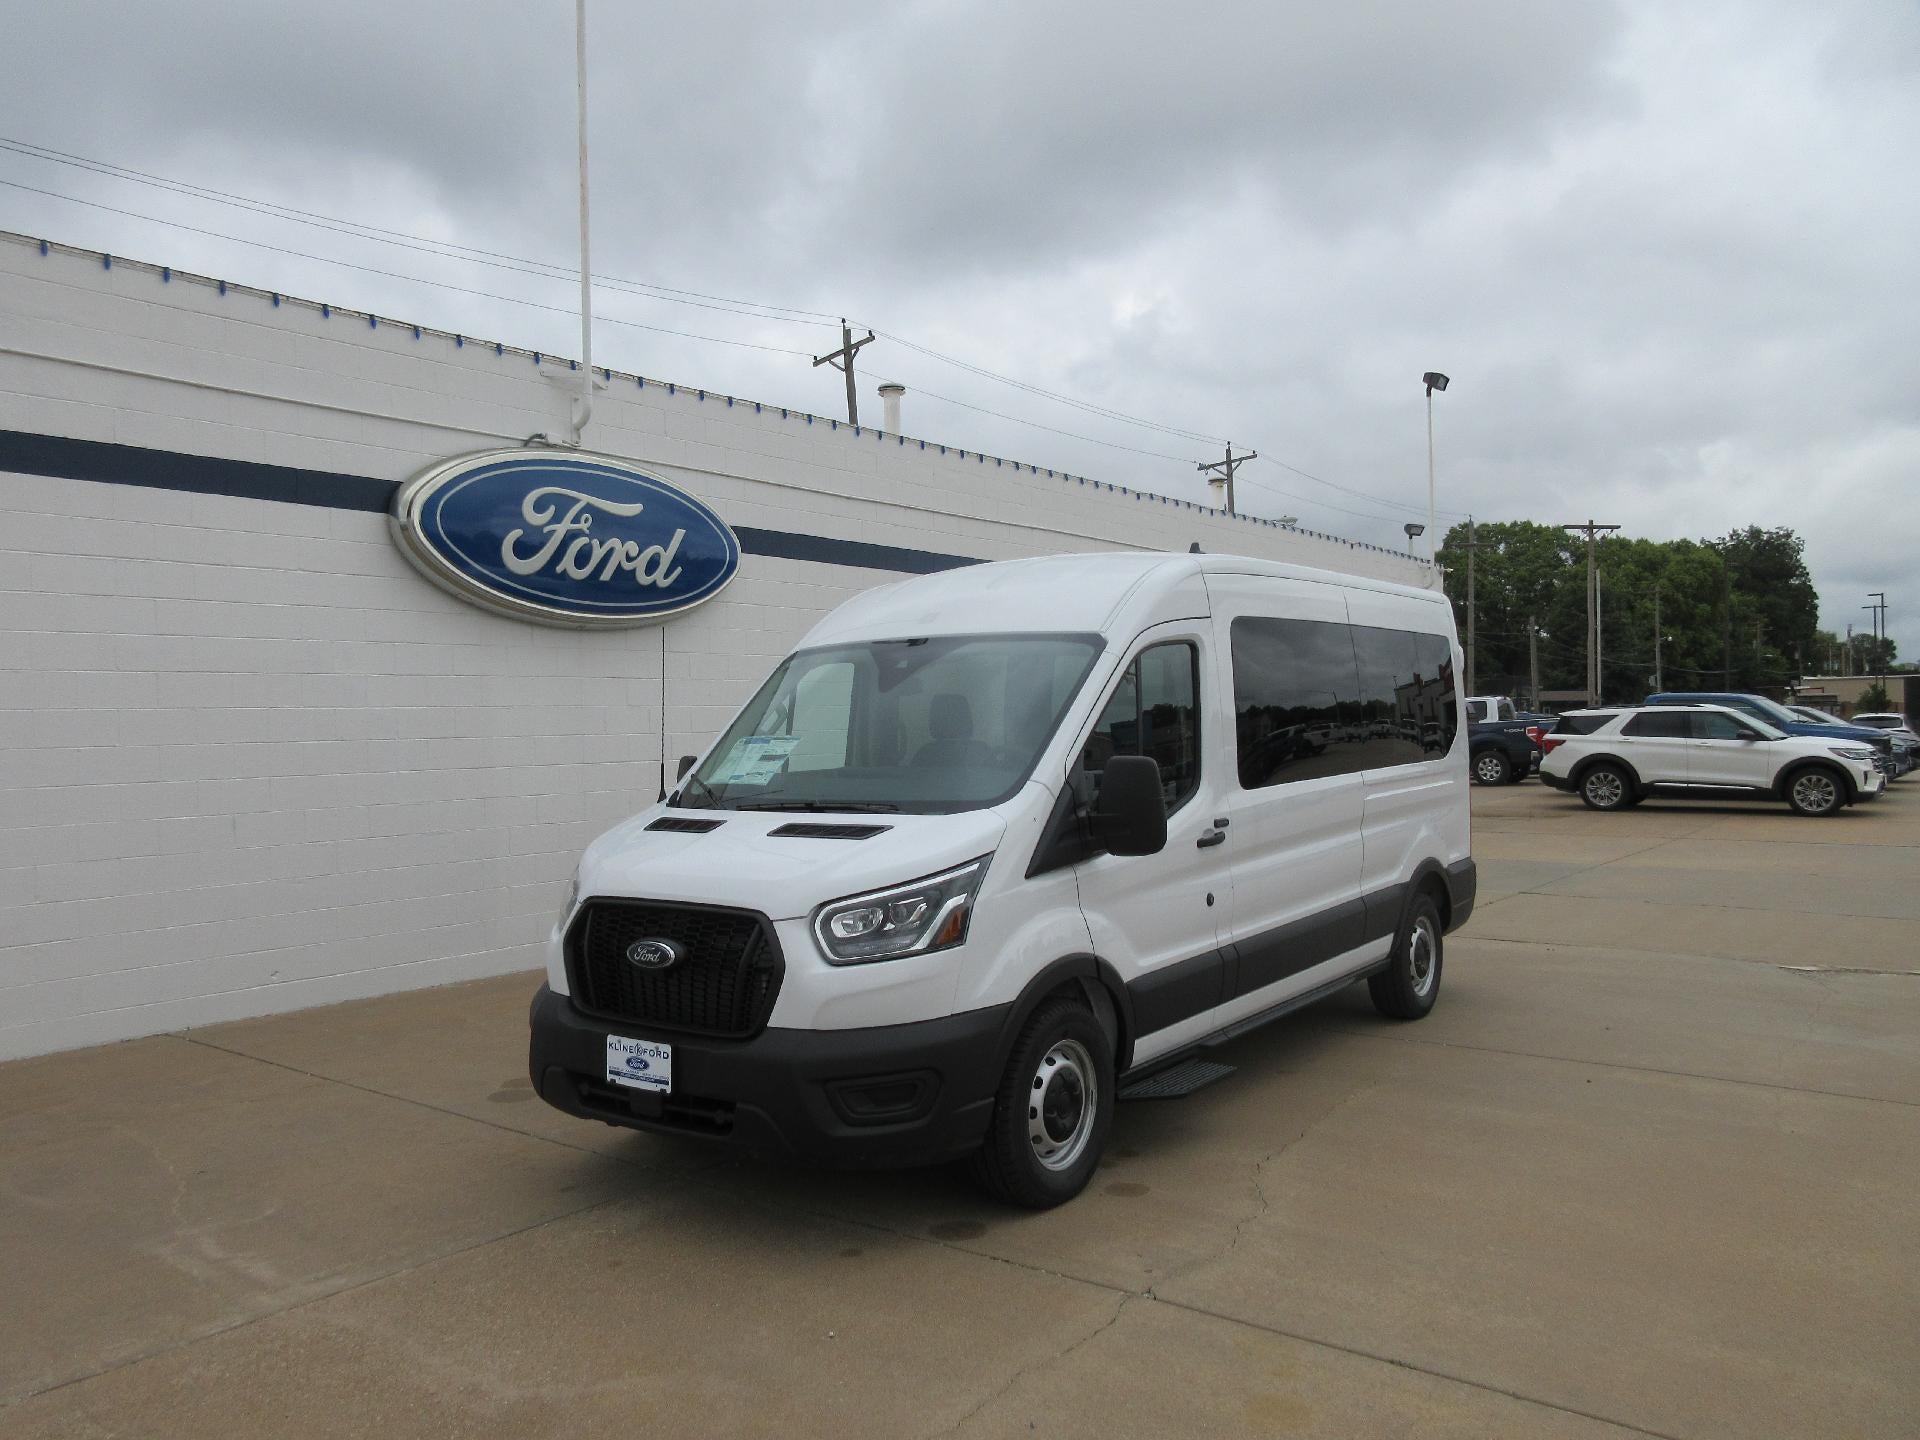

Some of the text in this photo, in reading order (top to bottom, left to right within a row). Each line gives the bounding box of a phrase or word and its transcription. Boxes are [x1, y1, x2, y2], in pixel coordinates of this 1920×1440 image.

[501, 486, 686, 588] Ford
[634, 945, 661, 963] Ford
[608, 1041, 634, 1054] KLINE
[643, 1048, 669, 1060] FORD
